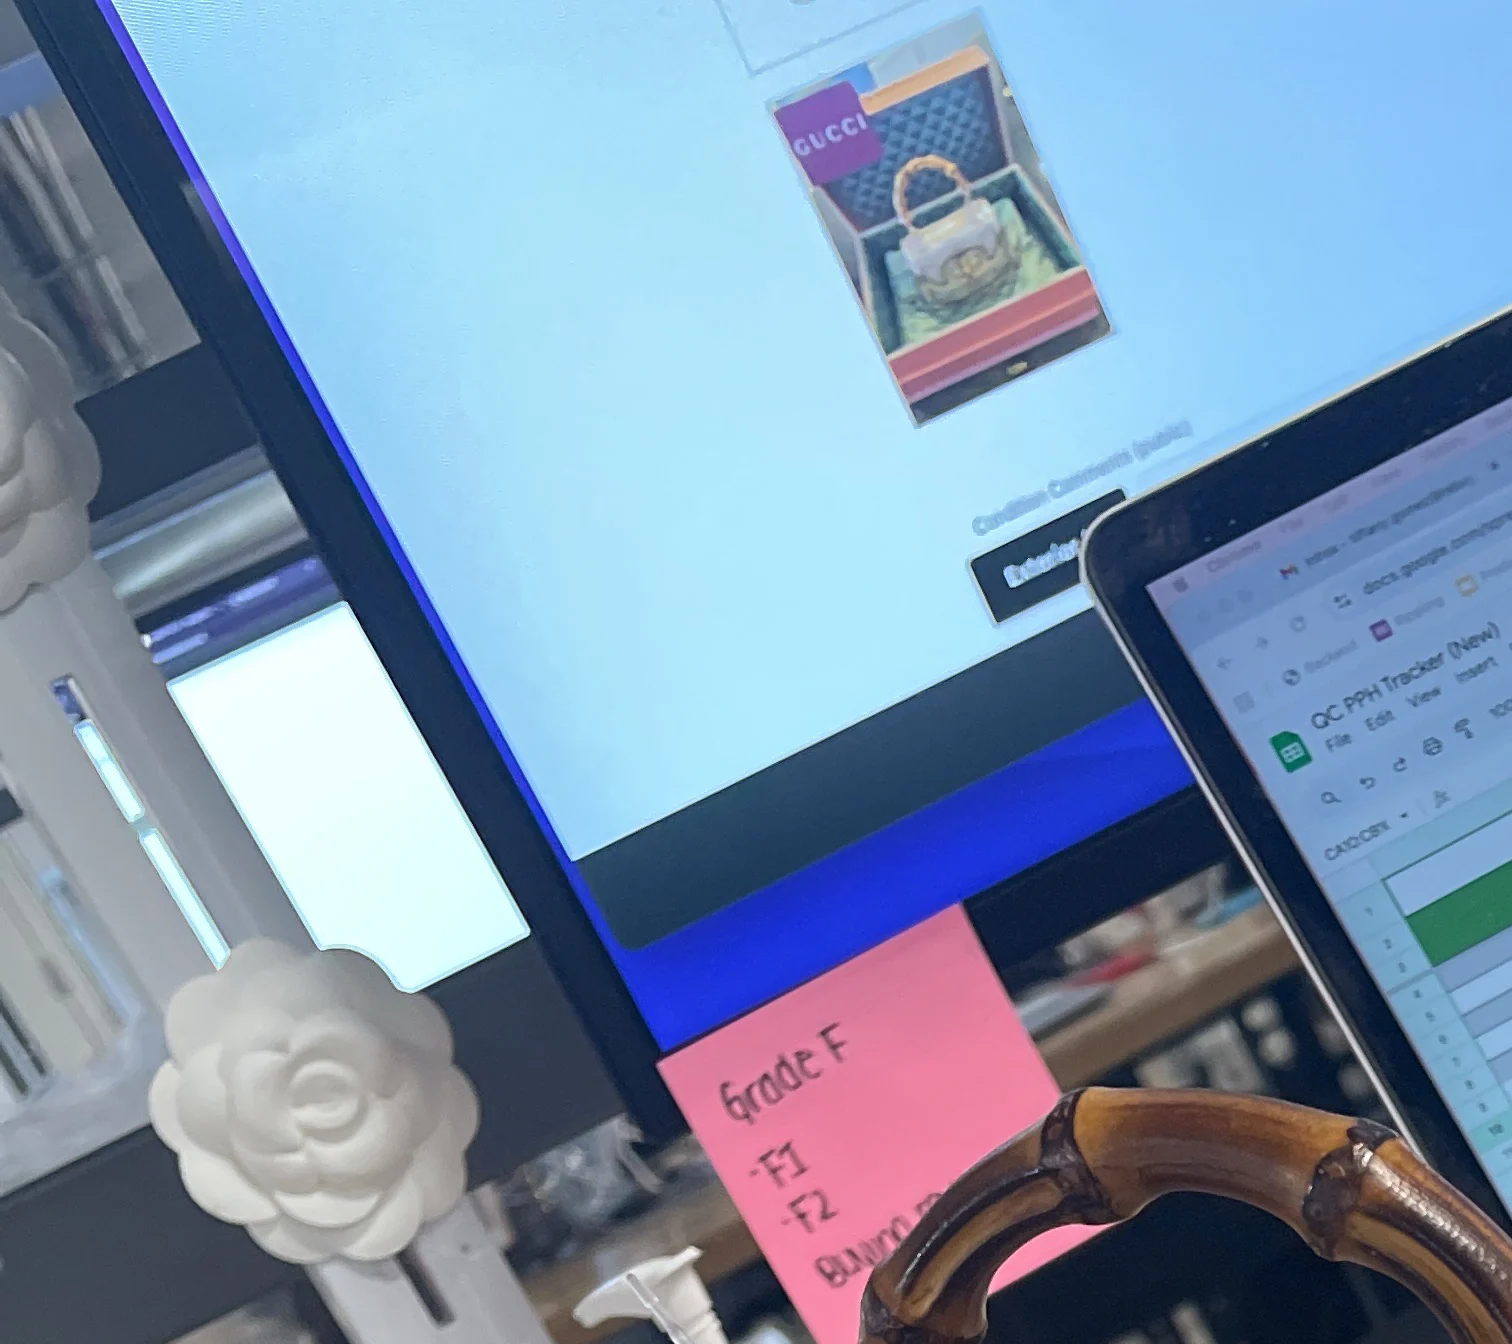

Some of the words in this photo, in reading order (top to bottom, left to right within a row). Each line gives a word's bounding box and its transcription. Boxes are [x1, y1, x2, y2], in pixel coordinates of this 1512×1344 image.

[793, 112, 868, 158] GUCCI
[1307, 700, 1346, 732] QC
[1340, 681, 1385, 714] PPH
[1378, 648, 1450, 695] Tracker
[1443, 618, 1504, 662] (New)
[1323, 728, 1355, 754] File
[1362, 706, 1397, 733] Edit
[719, 1049, 822, 1125] Grade
[818, 1022, 848, 1064] F
